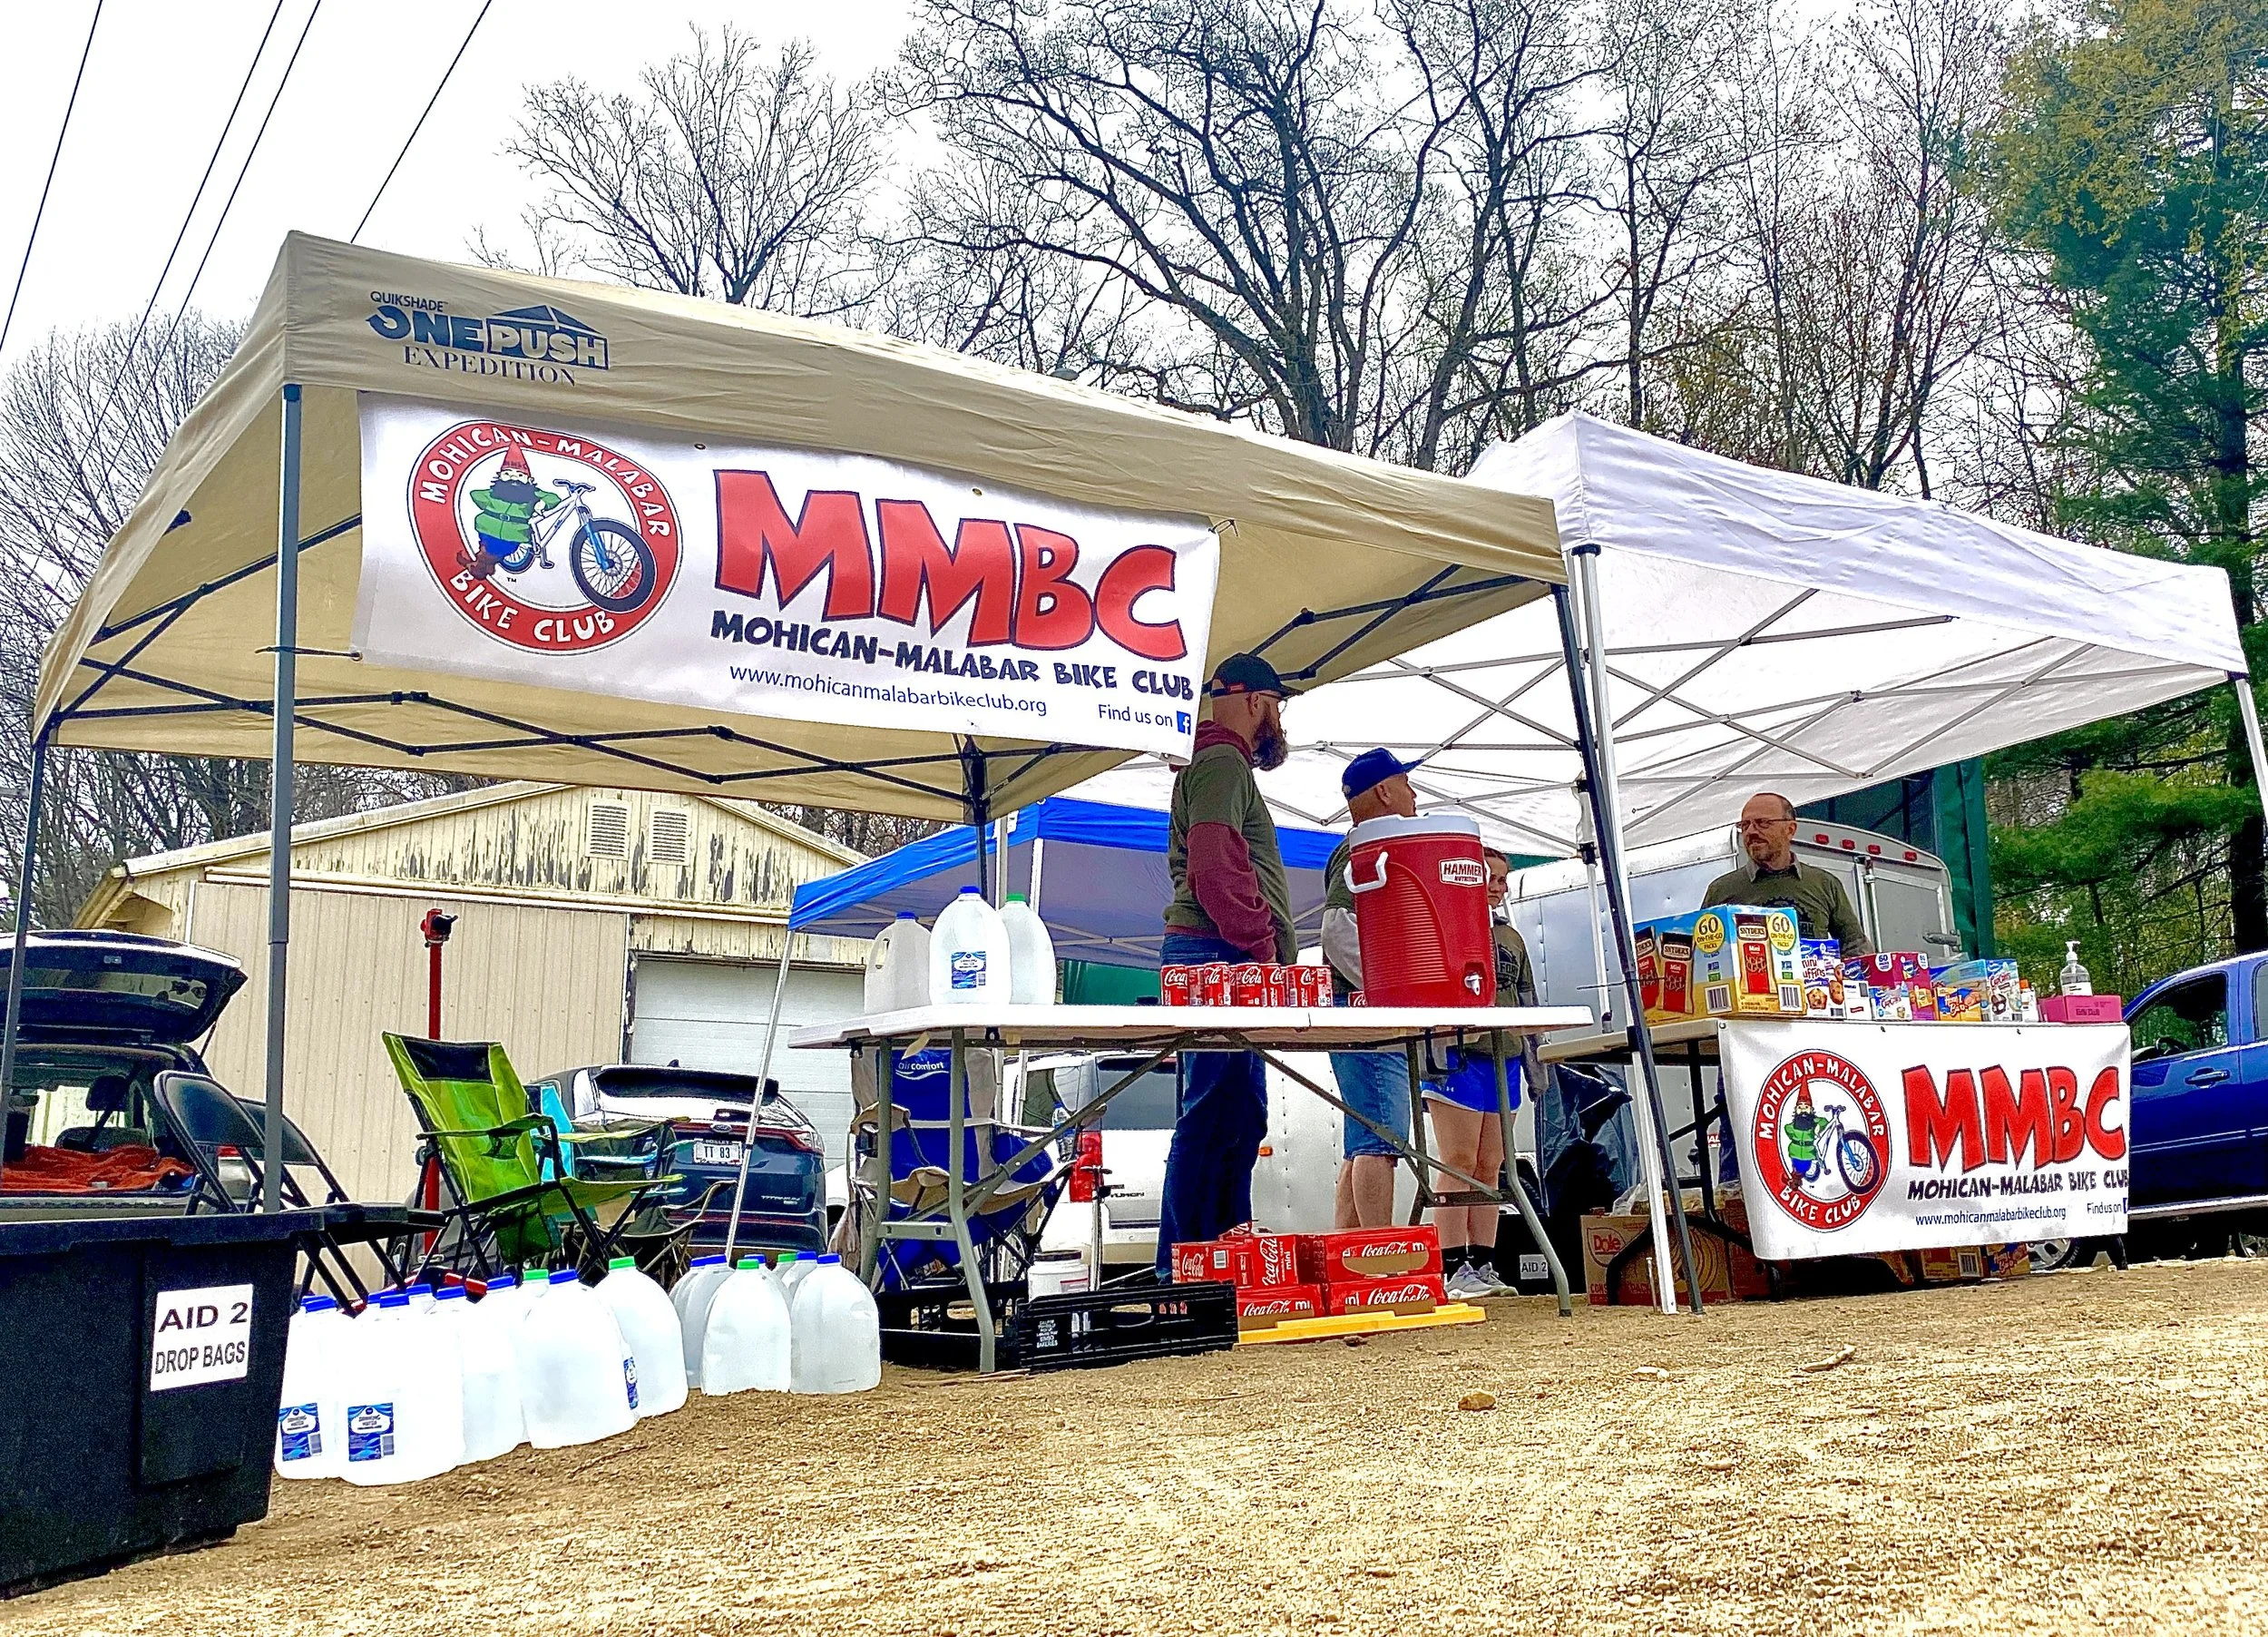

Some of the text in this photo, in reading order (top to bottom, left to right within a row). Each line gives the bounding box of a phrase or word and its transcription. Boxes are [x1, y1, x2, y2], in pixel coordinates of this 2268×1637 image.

[370, 290, 445, 312] QUIKSHADE
[404, 346, 576, 387] EXPEDITION
[419, 426, 671, 538] MOHICAN-MALABAR
[714, 469, 1188, 662] MMBC
[450, 569, 615, 643] BIKE CLUB
[709, 610, 1194, 701] MOHICAN-MALABAR BIKE CLUB
[729, 665, 1047, 716] www.mohicanmalabarbikeclub.org
[1099, 704, 1130, 722] Find
[1135, 711, 1153, 725] us
[1155, 713, 1173, 728] on
[1443, 863, 1482, 877] HAMMER
[1698, 917, 1719, 936] 60
[1772, 917, 1790, 934] 60
[1878, 954, 1889, 963] 60
[910, 1060, 944, 1070] comfort
[1759, 1057, 1885, 1140] MOHICAN-MALABAR
[1901, 1064, 2127, 1174] MMBC
[704, 1146, 730, 1159] TT 83
[1907, 1172, 2063, 1201] MOHICAN-MALABAR
[2068, 1171, 2097, 1191] BIKE
[1779, 1185, 1862, 1224] BIKE CLUB
[1915, 1207, 2067, 1226] www.mohicanmalabarbikeclub.org
[2087, 1203, 2104, 1215] Find
[1593, 1234, 1621, 1252] Dole
[1520, 1261, 1548, 1273] AID 2
[158, 1301, 249, 1333] AID 2
[154, 1340, 246, 1375] DROP BAGS
